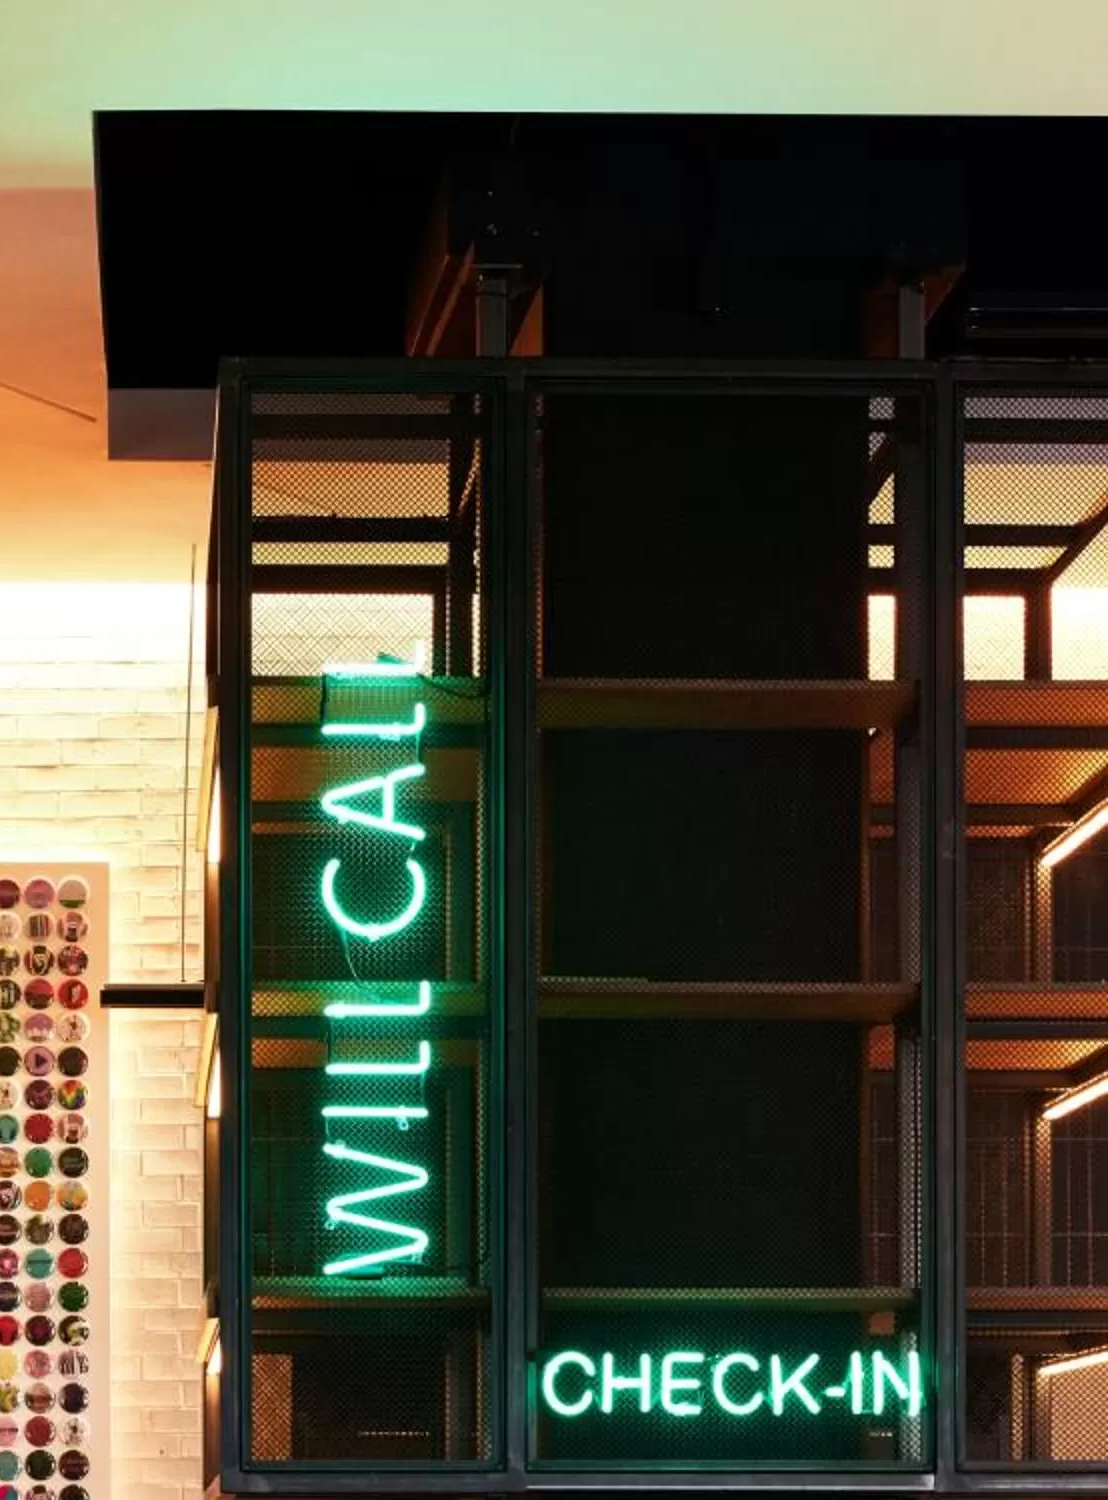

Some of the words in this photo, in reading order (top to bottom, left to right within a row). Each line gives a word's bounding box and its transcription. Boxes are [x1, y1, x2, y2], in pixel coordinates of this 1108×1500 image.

[322, 640, 426, 940] CALL
[322, 980, 430, 1276] WILL
[541, 1350, 923, 1418] CHECK-IN
